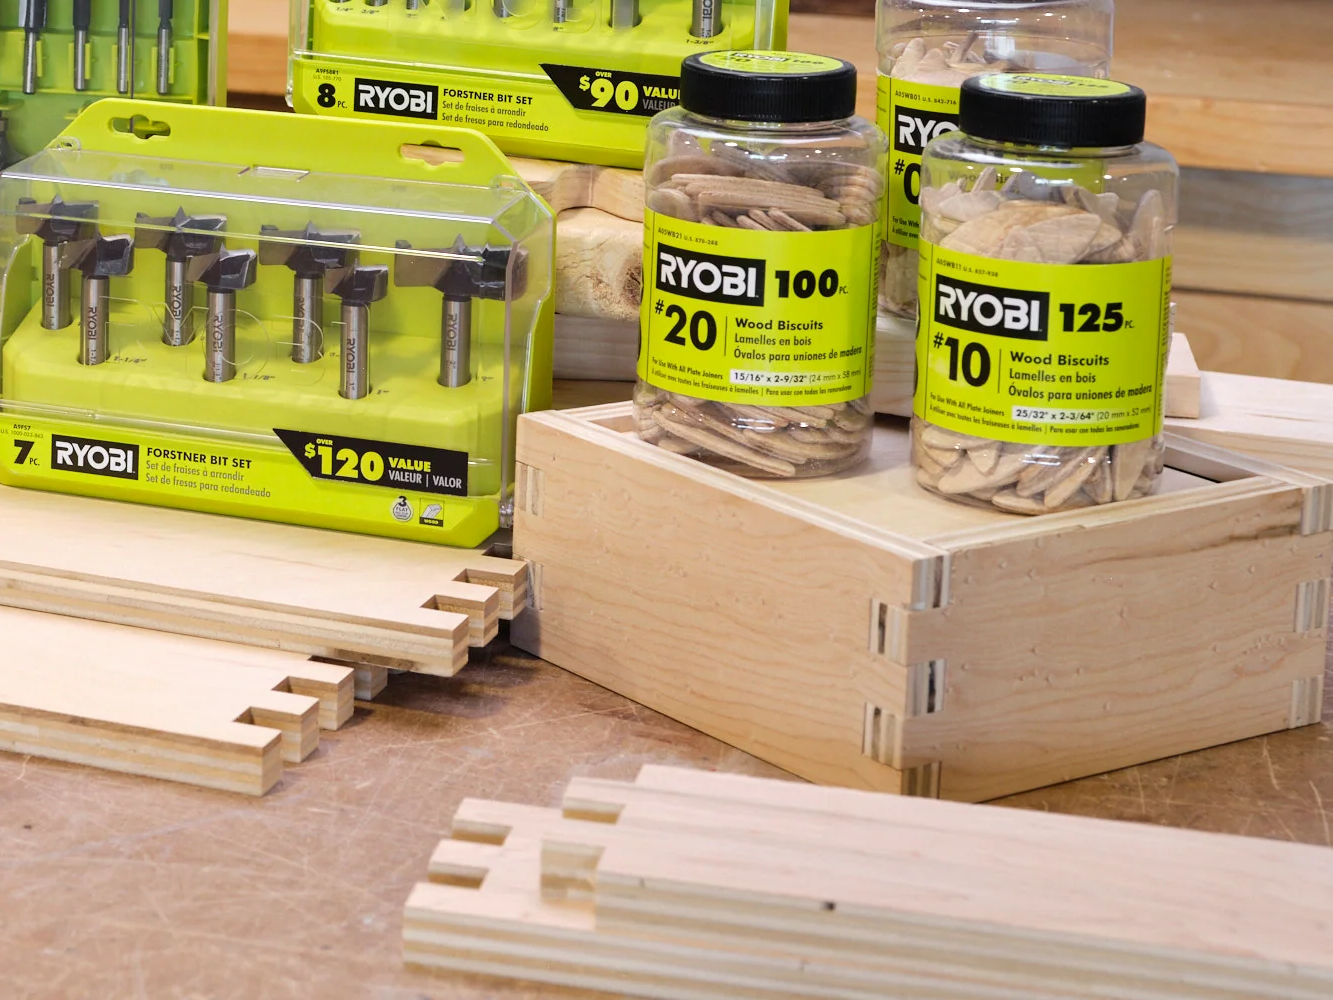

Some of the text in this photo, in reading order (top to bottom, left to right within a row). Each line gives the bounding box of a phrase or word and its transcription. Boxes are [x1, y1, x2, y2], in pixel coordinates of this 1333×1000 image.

[317, 83, 336, 108] 8
[358, 84, 432, 113] RYOBI
[443, 89, 533, 105] FORSTNER BIT SET
[579, 75, 639, 110] $90
[443, 101, 453, 109] Set
[455, 102, 463, 110] de
[466, 103, 488, 113] fraises
[497, 108, 526, 117] arrondir
[455, 114, 463, 122] de
[466, 115, 485, 125] fresas
[506, 120, 548, 131] redondeado
[660, 251, 849, 299] RYOBI 100 PC.
[45, 274, 55, 307] RYOBI
[172, 285, 182, 320] RYOBI
[938, 284, 1135, 332] RYOBI 125 PC.
[87, 306, 97, 340] RYOBI
[213, 315, 223, 353] RYOBI
[447, 314, 457, 351] RYOBI
[654, 299, 717, 351] #20
[736, 315, 823, 331] Wood Biscuits
[735, 332, 812, 346] Lamelles en bois
[346, 338, 355, 373] RYOBI
[734, 346, 862, 363] Óvalos para uniones de madera
[933, 332, 991, 387] #10
[1010, 351, 1109, 366] Wood Biscuits
[734, 372, 764, 382] 15/16"
[775, 374, 807, 383] 2-9/32"
[809, 373, 820, 384] (24
[842, 370, 849, 379] 58
[851, 367, 862, 377] mm)
[1009, 368, 1096, 383] Lamelles en bois
[1009, 385, 1152, 402] Óvalos para uniones de madera
[1016, 409, 1048, 418] 25/32"
[1060, 411, 1094, 420] 2-3/64"
[1097, 411, 1109, 421] (20
[1141, 407, 1151, 416] mm)
[14, 439, 40, 466] 7 PC.
[56, 441, 133, 473] RYOBI
[147, 448, 252, 469] FORSTNER BIT SET
[304, 443, 385, 481] $120
[388, 457, 432, 472] VALUE
[146, 461, 244, 481] Set de fraises à arrondir
[388, 470, 462, 489] VALEUR VALOR
[146, 473, 270, 497] Set de fresas para redondeado
[398, 496, 407, 507] 3
